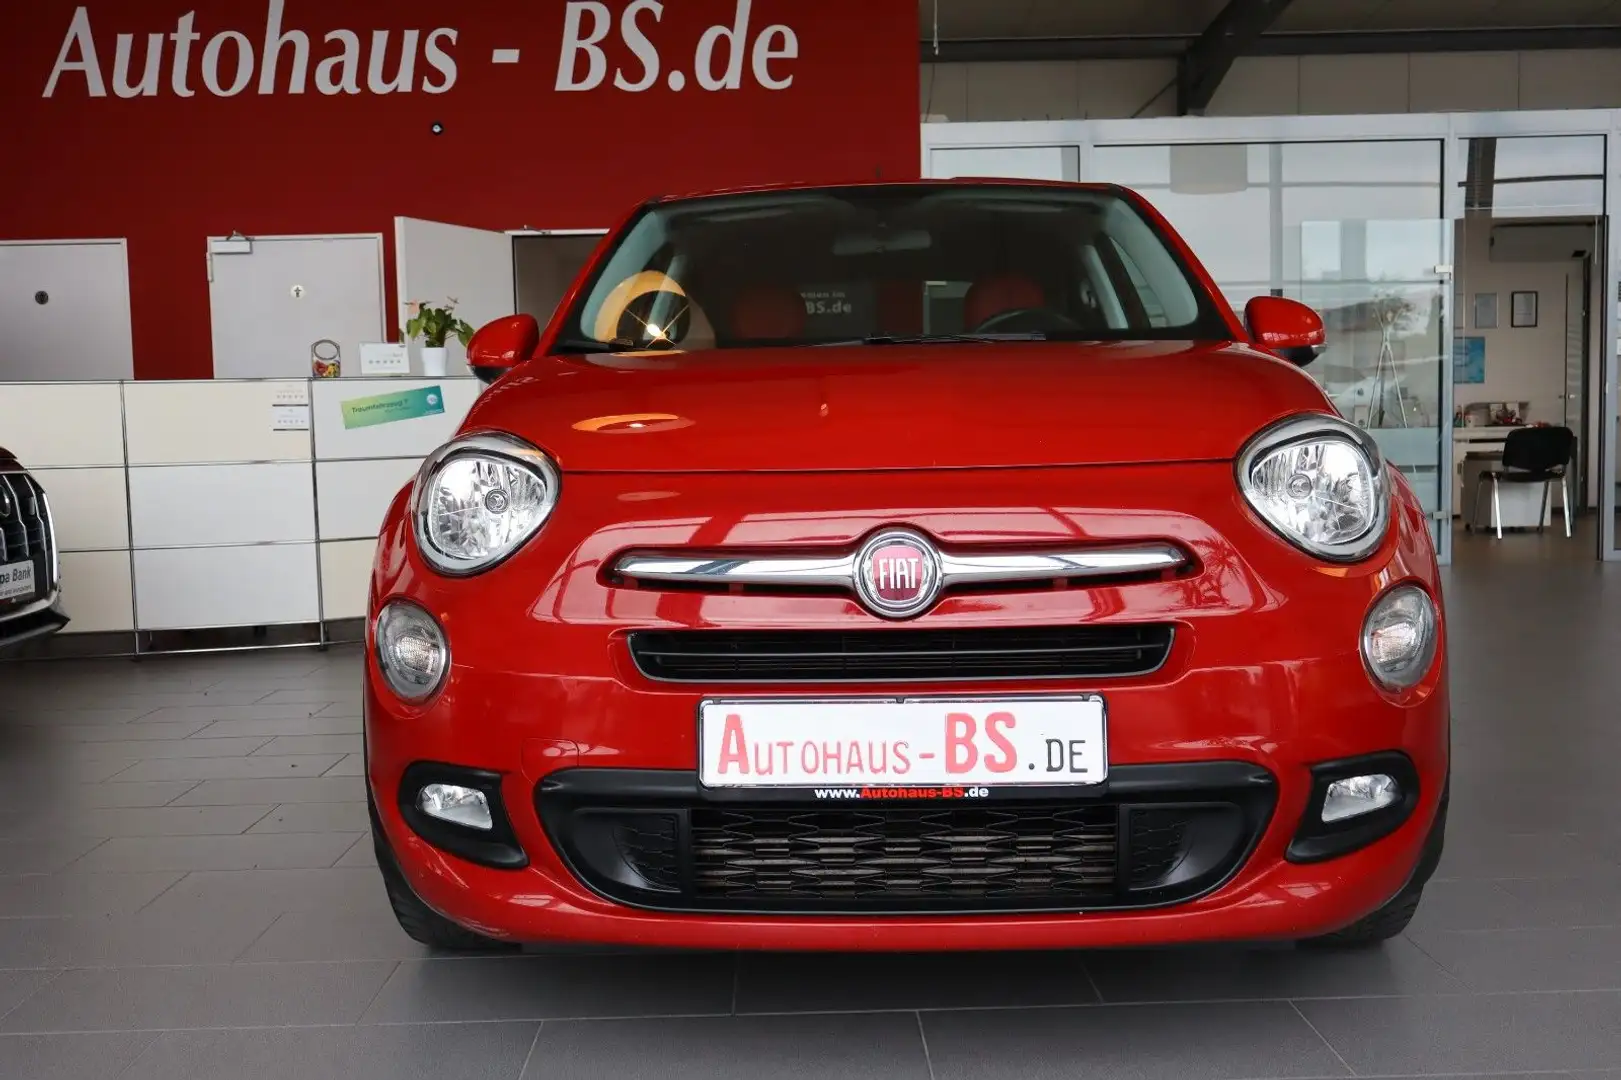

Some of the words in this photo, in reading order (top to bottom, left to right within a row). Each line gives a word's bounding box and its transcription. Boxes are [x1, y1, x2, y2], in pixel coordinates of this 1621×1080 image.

[42, 0, 458, 98] Autohaus
[492, 49, 520, 63] -
[554, 0, 799, 92] BS.de
[12, 566, 32, 582] Bank
[878, 558, 919, 590] FIAT
[814, 786, 989, 799] www.Autohaus-BS.de
